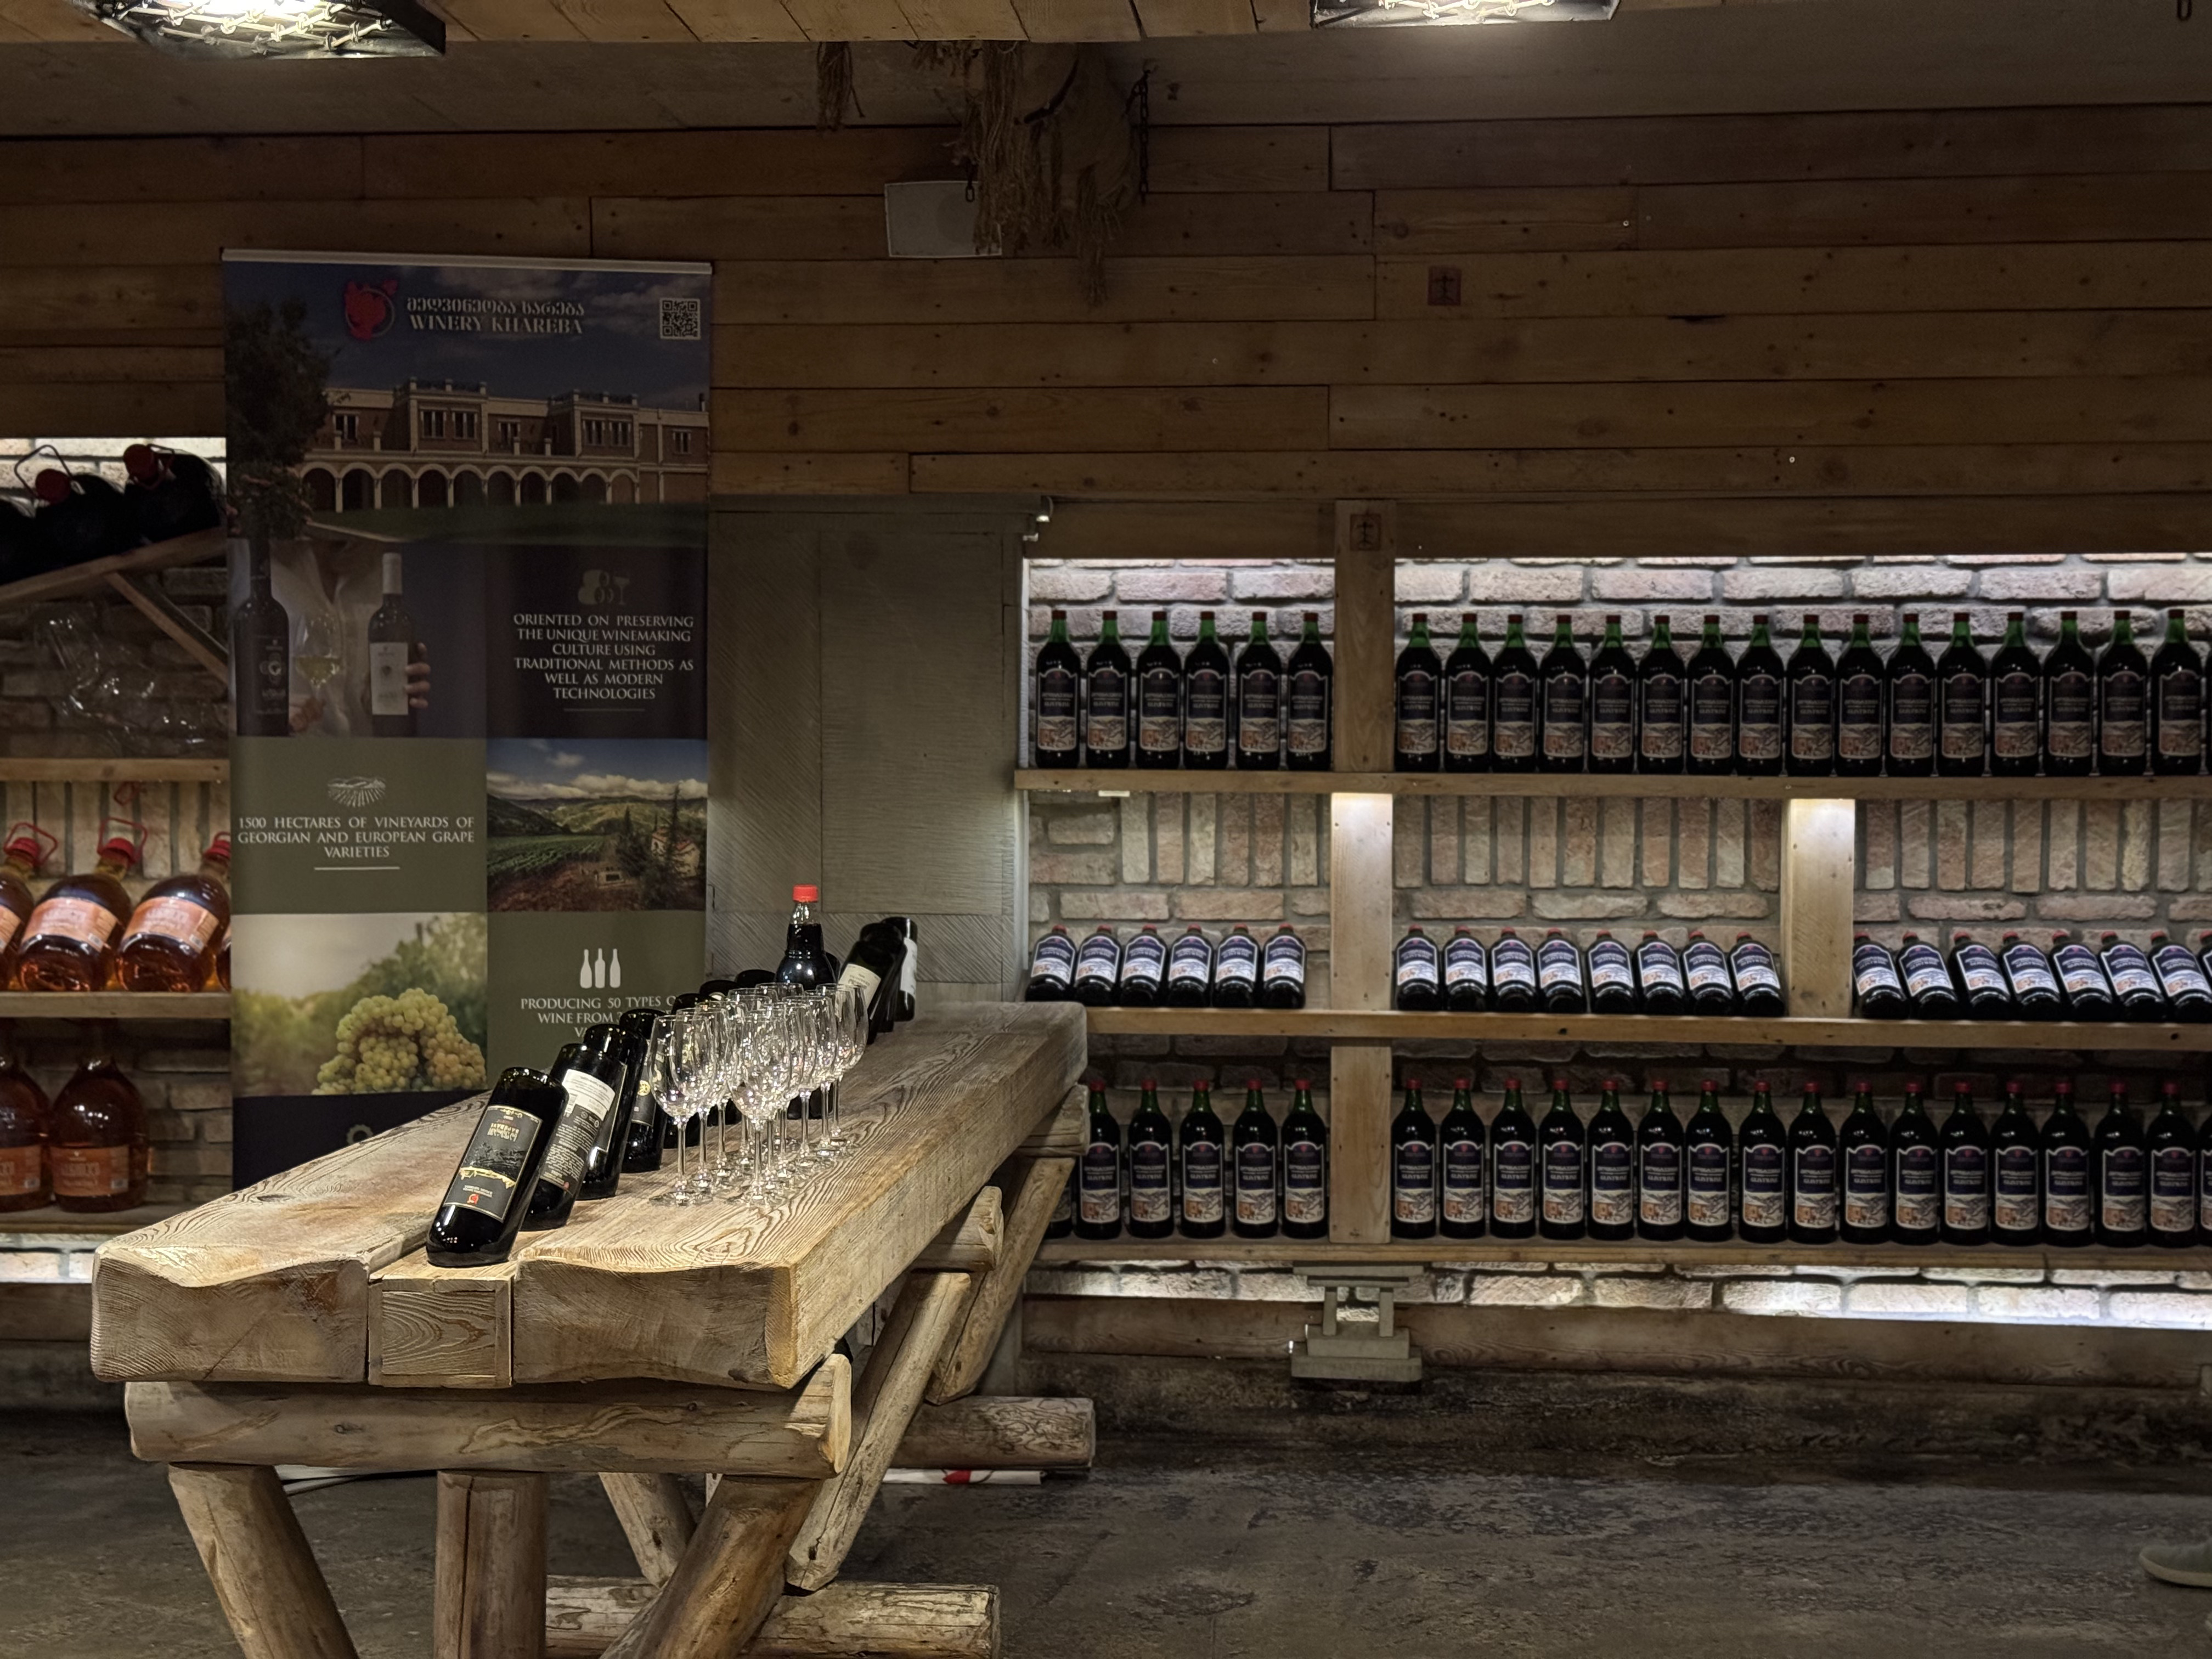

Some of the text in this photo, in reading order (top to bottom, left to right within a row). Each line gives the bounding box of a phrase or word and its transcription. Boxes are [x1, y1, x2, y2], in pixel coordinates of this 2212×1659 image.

[409, 314, 583, 334] WINERY KHAREBA
[514, 614, 694, 628] ORIENTED ON PRESERVING
[517, 628, 691, 642] THE UNIQUE WINEMAKING
[552, 643, 656, 656] CULTURE USING
[514, 658, 694, 671] TRADITIONAL METHODS AS
[545, 673, 663, 685] WELL AS MODERN
[552, 687, 656, 700] TECHNOLOGIES
[238, 816, 475, 829] 1500 HECTARES OF VINEYARDS OF
[238, 831, 475, 844] GEORGIAN AND EUROPEAN GRAPE
[324, 845, 390, 859] VARIETIES
[520, 995, 676, 1010] PRODUCING 50 TYPES O
[538, 1012, 573, 1024] WINE
[577, 1012, 614, 1024] FROM
